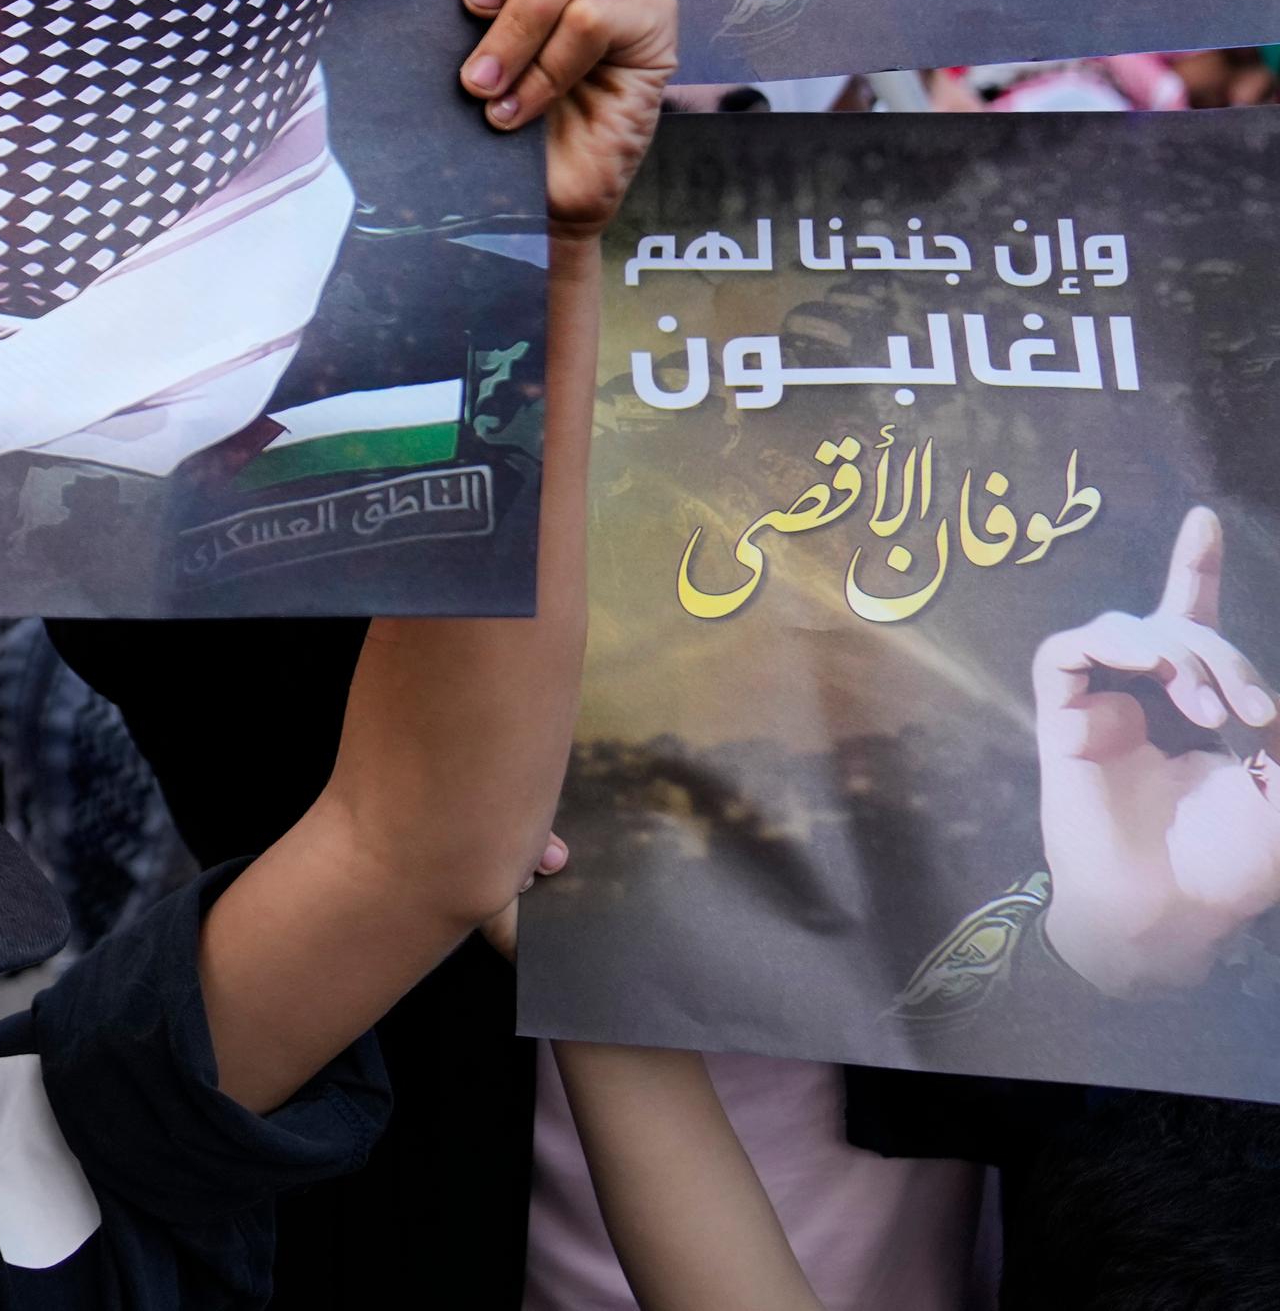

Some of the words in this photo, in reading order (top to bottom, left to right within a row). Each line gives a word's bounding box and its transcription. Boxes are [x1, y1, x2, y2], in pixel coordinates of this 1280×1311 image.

[624, 218, 774, 287] لهم
[798, 218, 973, 287] جندنا
[994, 218, 1130, 295] وإن
[676, 423, 934, 620] الأقصى
[844, 447, 1103, 623] طوفان
